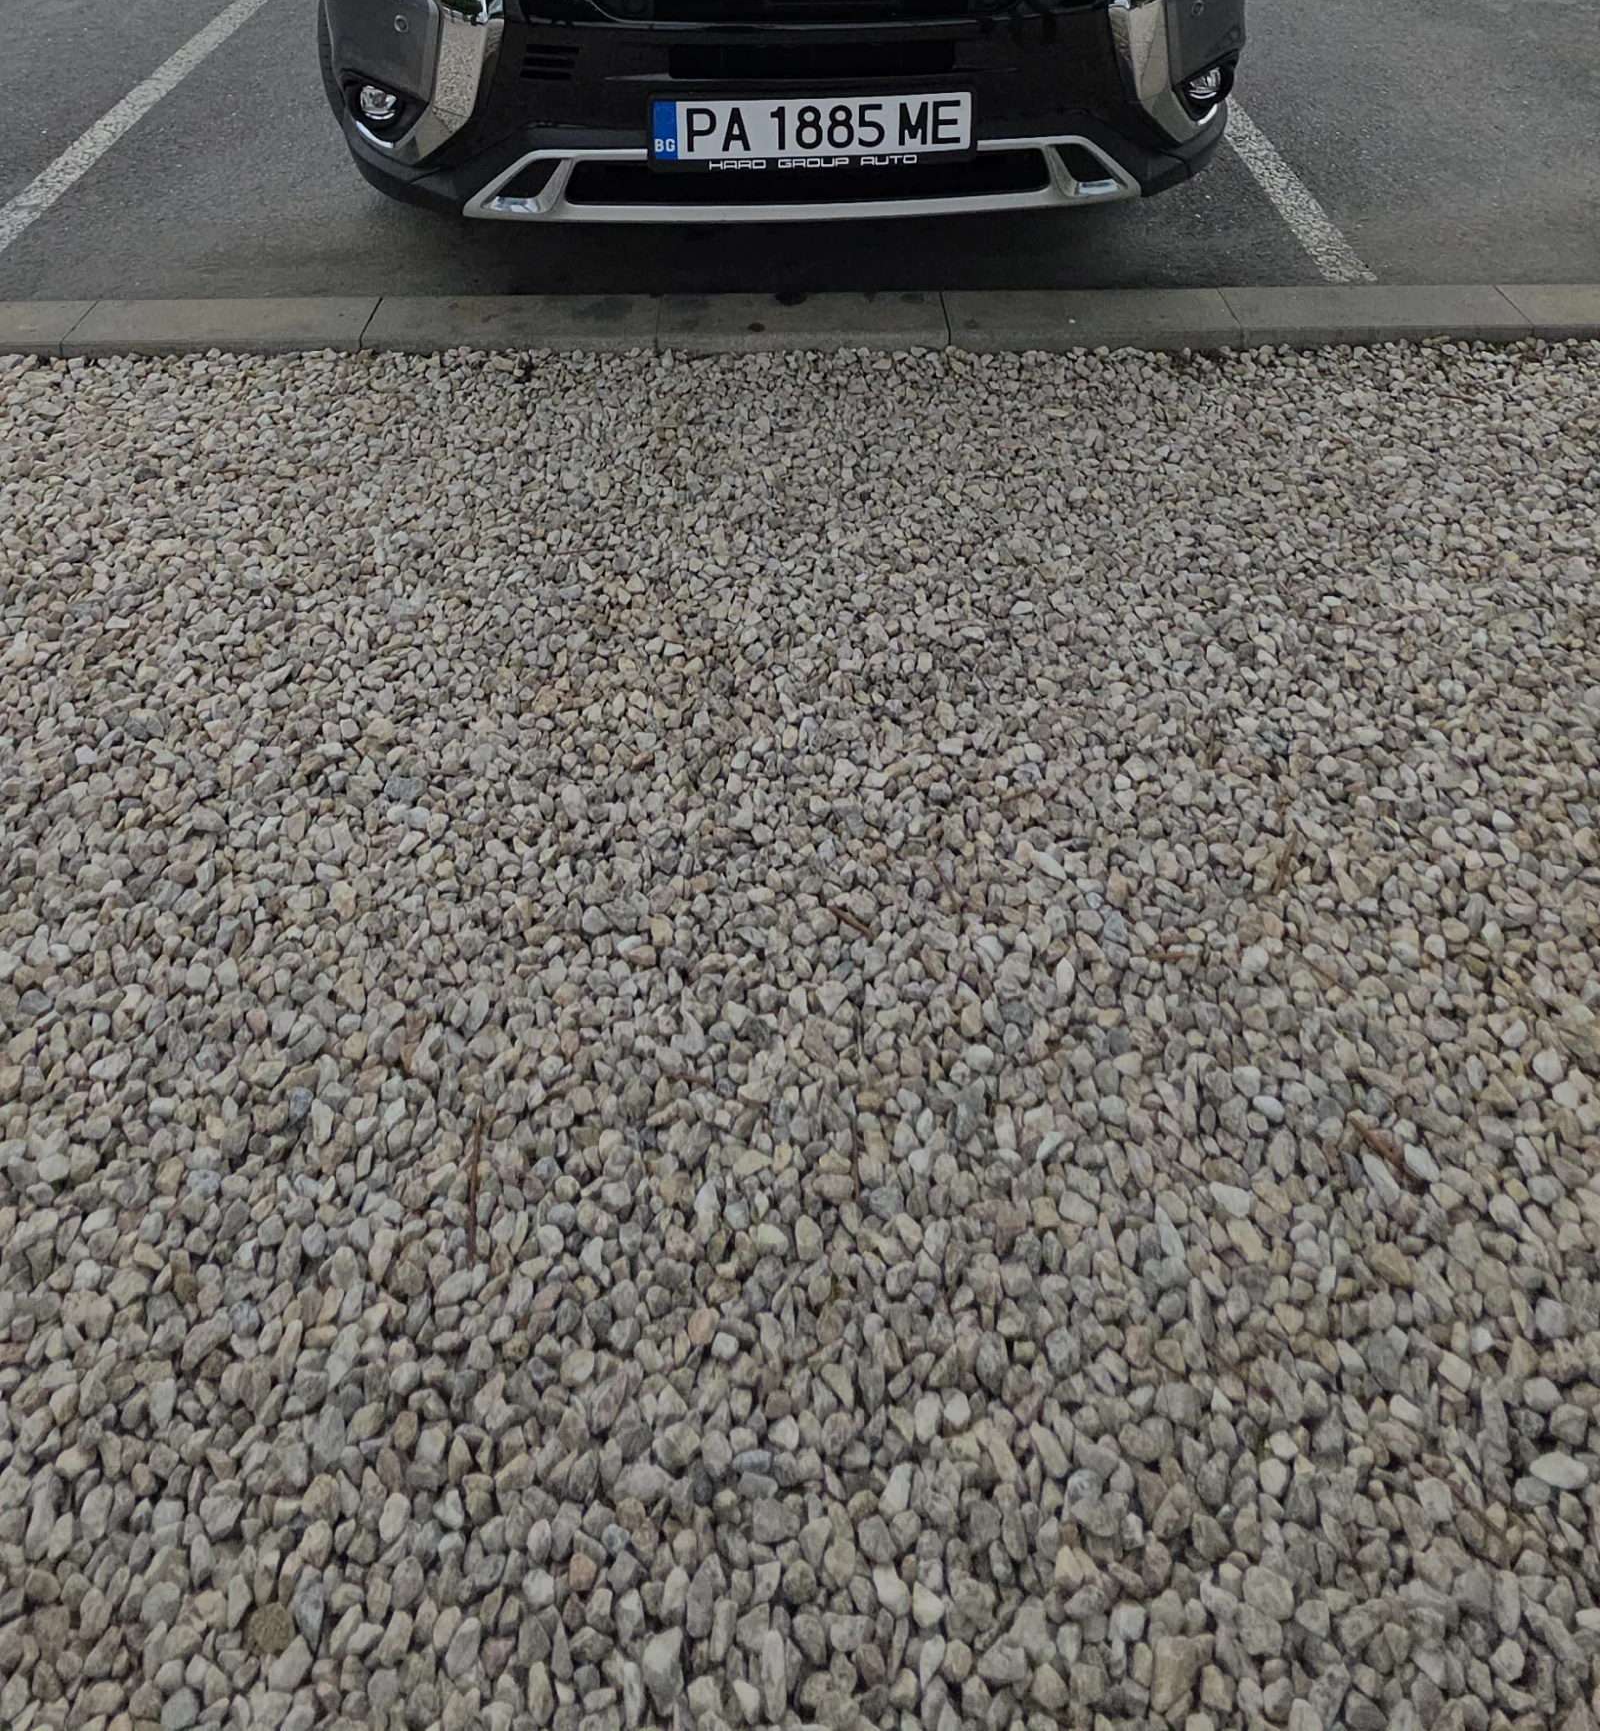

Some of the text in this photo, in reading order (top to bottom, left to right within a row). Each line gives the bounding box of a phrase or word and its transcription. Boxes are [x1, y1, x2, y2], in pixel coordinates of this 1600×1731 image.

[686, 99, 962, 153] PA 1885 ME
[654, 138, 676, 152] BG
[777, 157, 850, 169] GROUP
[860, 154, 918, 167] AUTO
